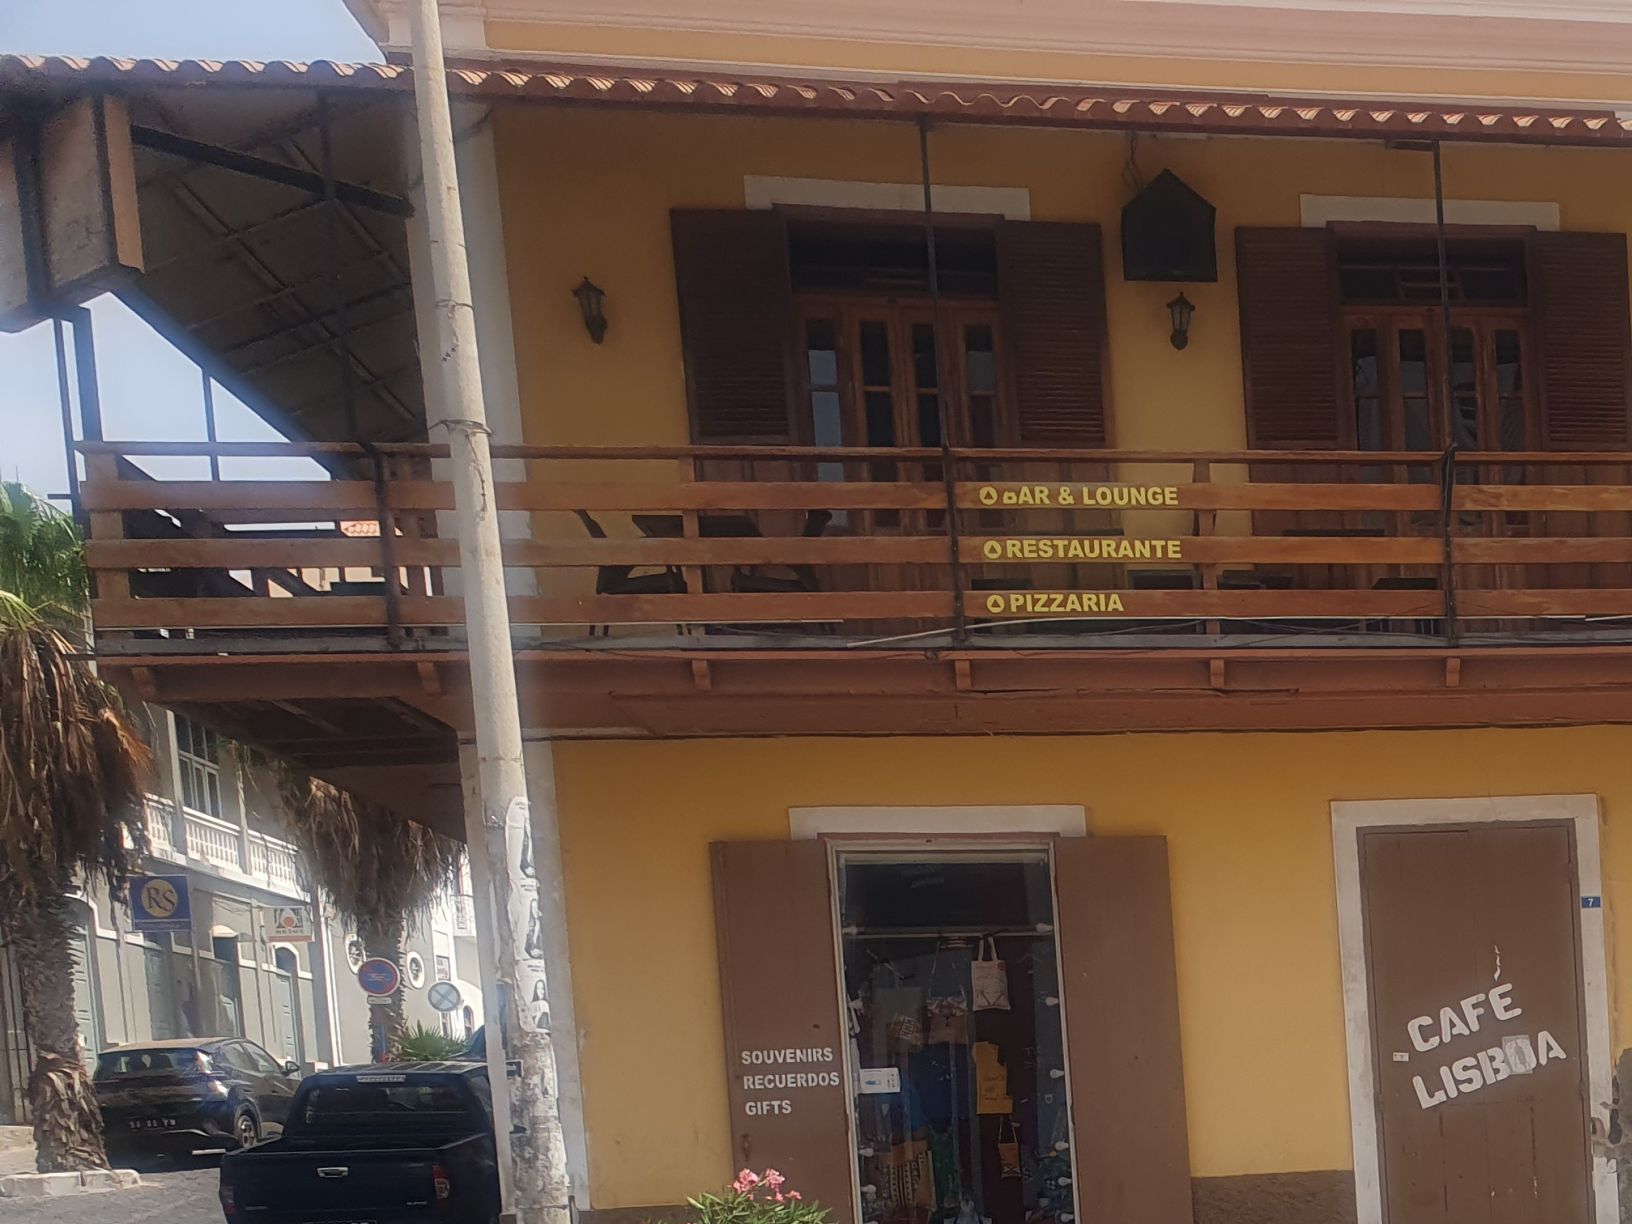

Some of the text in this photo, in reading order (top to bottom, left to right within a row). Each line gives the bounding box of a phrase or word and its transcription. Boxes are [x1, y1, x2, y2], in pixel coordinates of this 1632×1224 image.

[1058, 486, 1075, 505] &
[1082, 486, 1179, 506] LOUNGE
[1006, 540, 1182, 559] RESTAURANTE
[1010, 593, 1124, 613] PIZZARIA
[741, 1048, 833, 1065] SOUVENIRS
[1412, 1030, 1567, 1110] LISBOA
[743, 1072, 840, 1090] RECUERDOS
[745, 1100, 792, 1116] GIFTS
